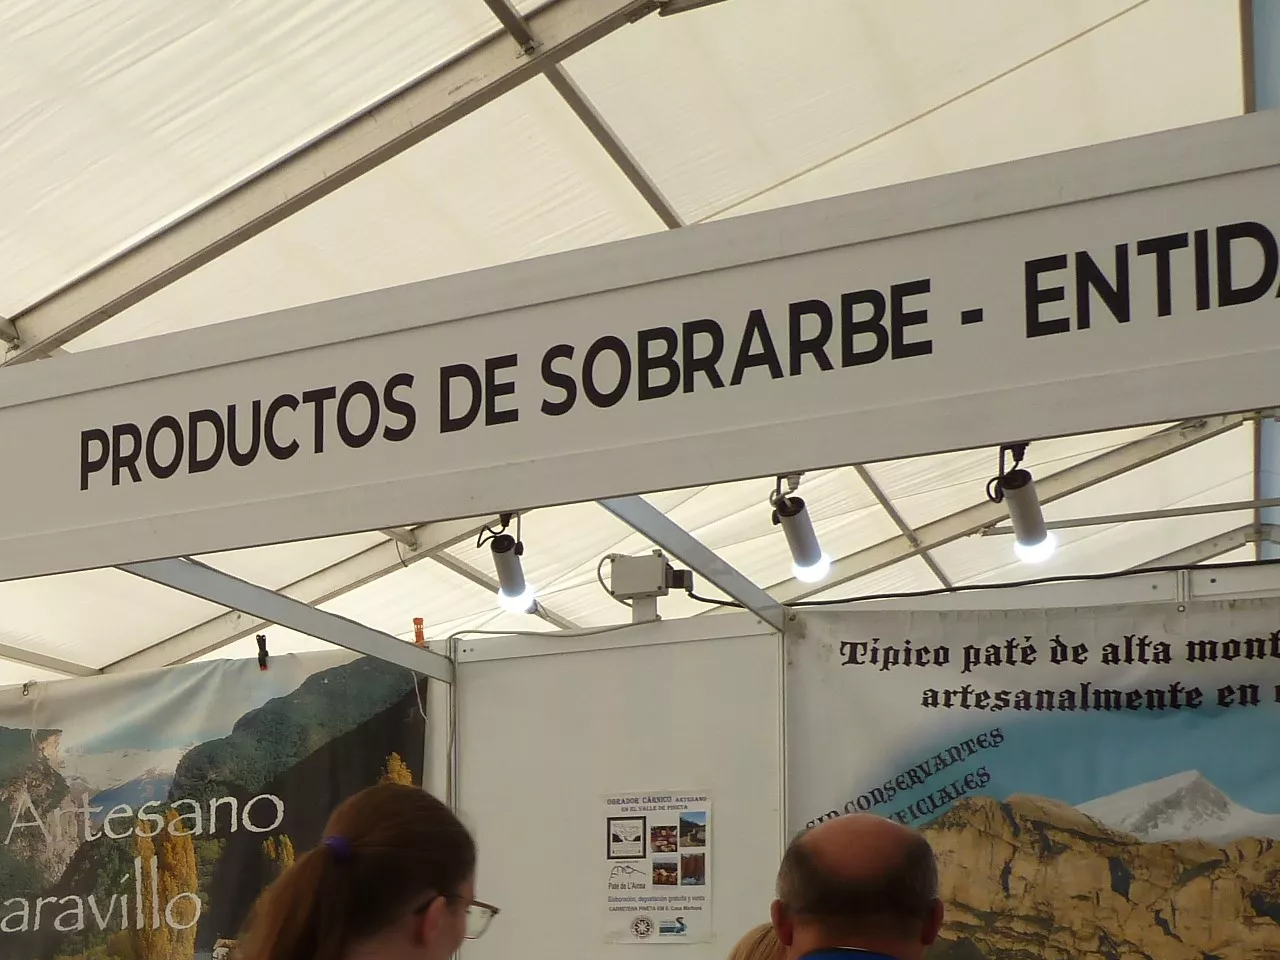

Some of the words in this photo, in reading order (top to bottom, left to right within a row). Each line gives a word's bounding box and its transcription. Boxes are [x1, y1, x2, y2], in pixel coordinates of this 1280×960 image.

[79, 372, 416, 492] PRODUCTOS
[439, 352, 519, 434] DE
[540, 278, 935, 417] SOBRARBE
[1024, 219, 1280, 338] ENTID
[840, 637, 950, 672] Típico
[962, 635, 1037, 673] paté
[1050, 634, 1088, 666] de
[1101, 634, 1172, 667] alta
[921, 682, 1203, 713] artesanalmente
[1216, 683, 1261, 708] en
[844, 727, 1004, 814] CONSERVANTES
[4, 793, 286, 847] Artesano
